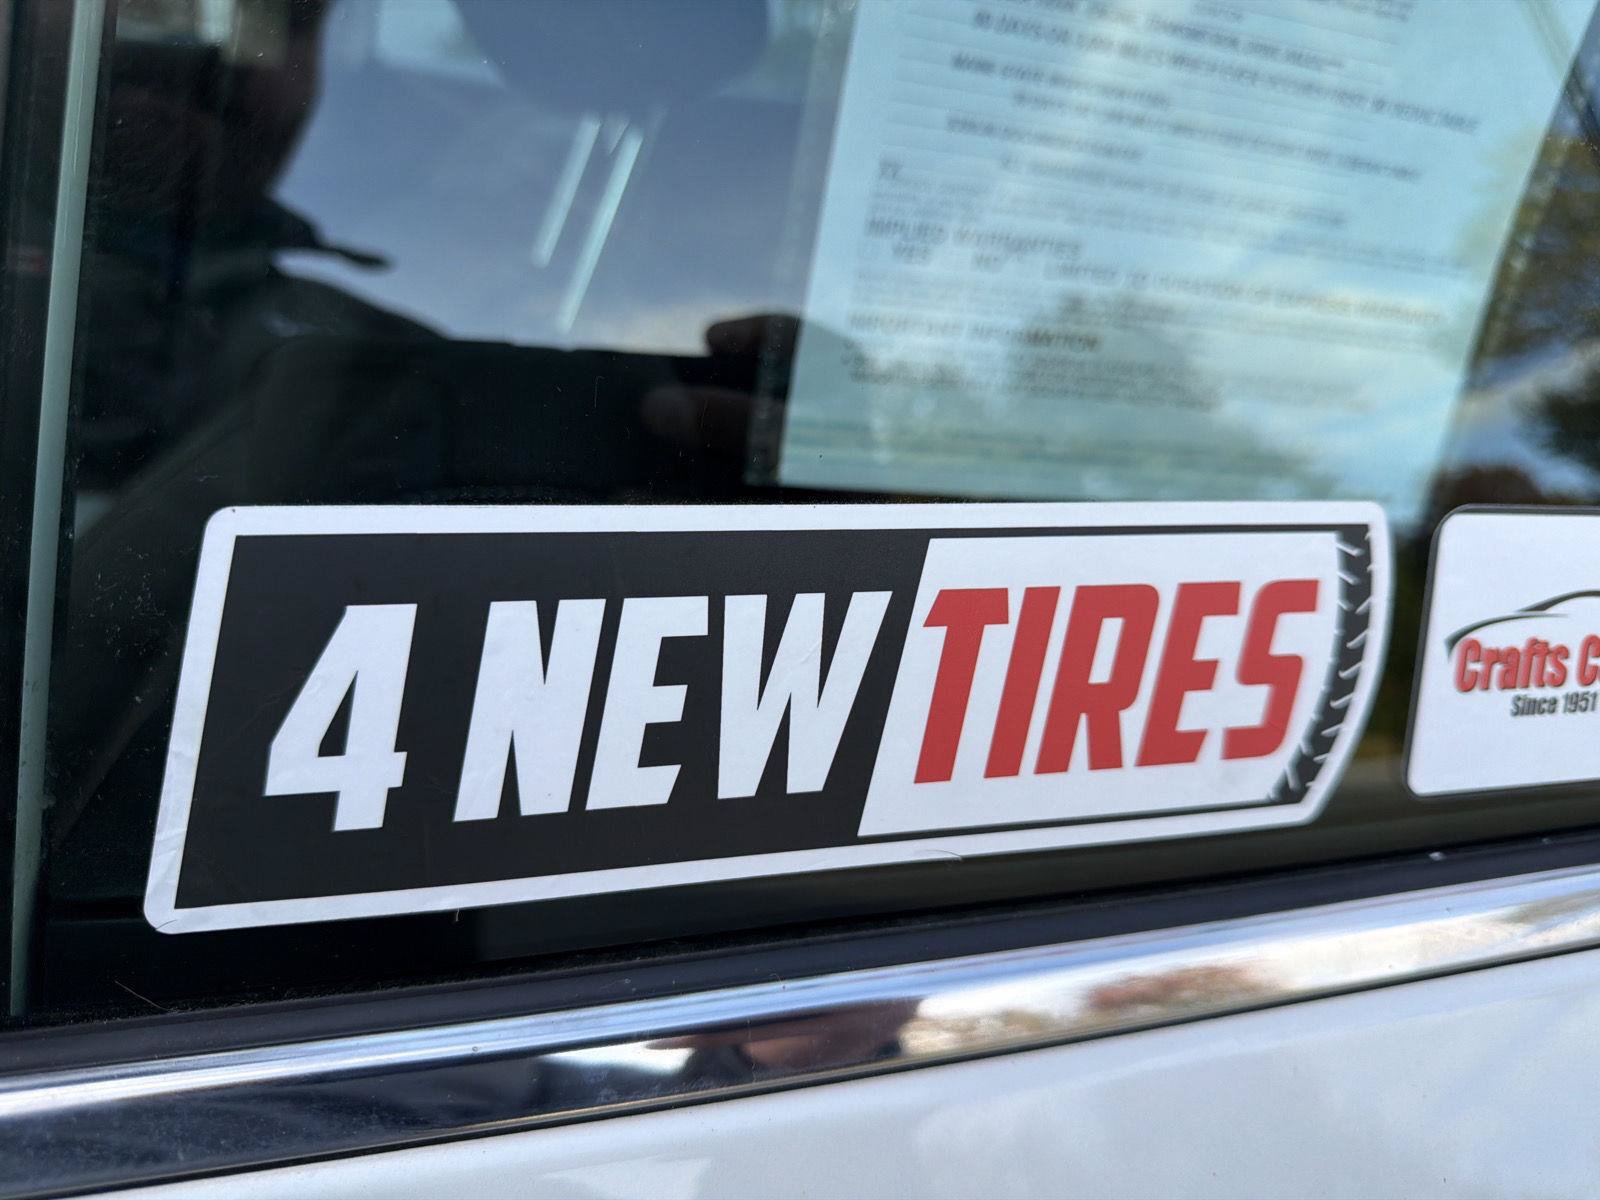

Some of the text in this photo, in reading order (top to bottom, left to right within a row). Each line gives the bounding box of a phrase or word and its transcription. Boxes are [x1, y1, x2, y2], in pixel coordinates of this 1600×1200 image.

[1455, 633, 1600, 692] Crafts C
[264, 578, 1319, 832] 4 NEW TIRES
[1510, 690, 1597, 717] Since 1951
